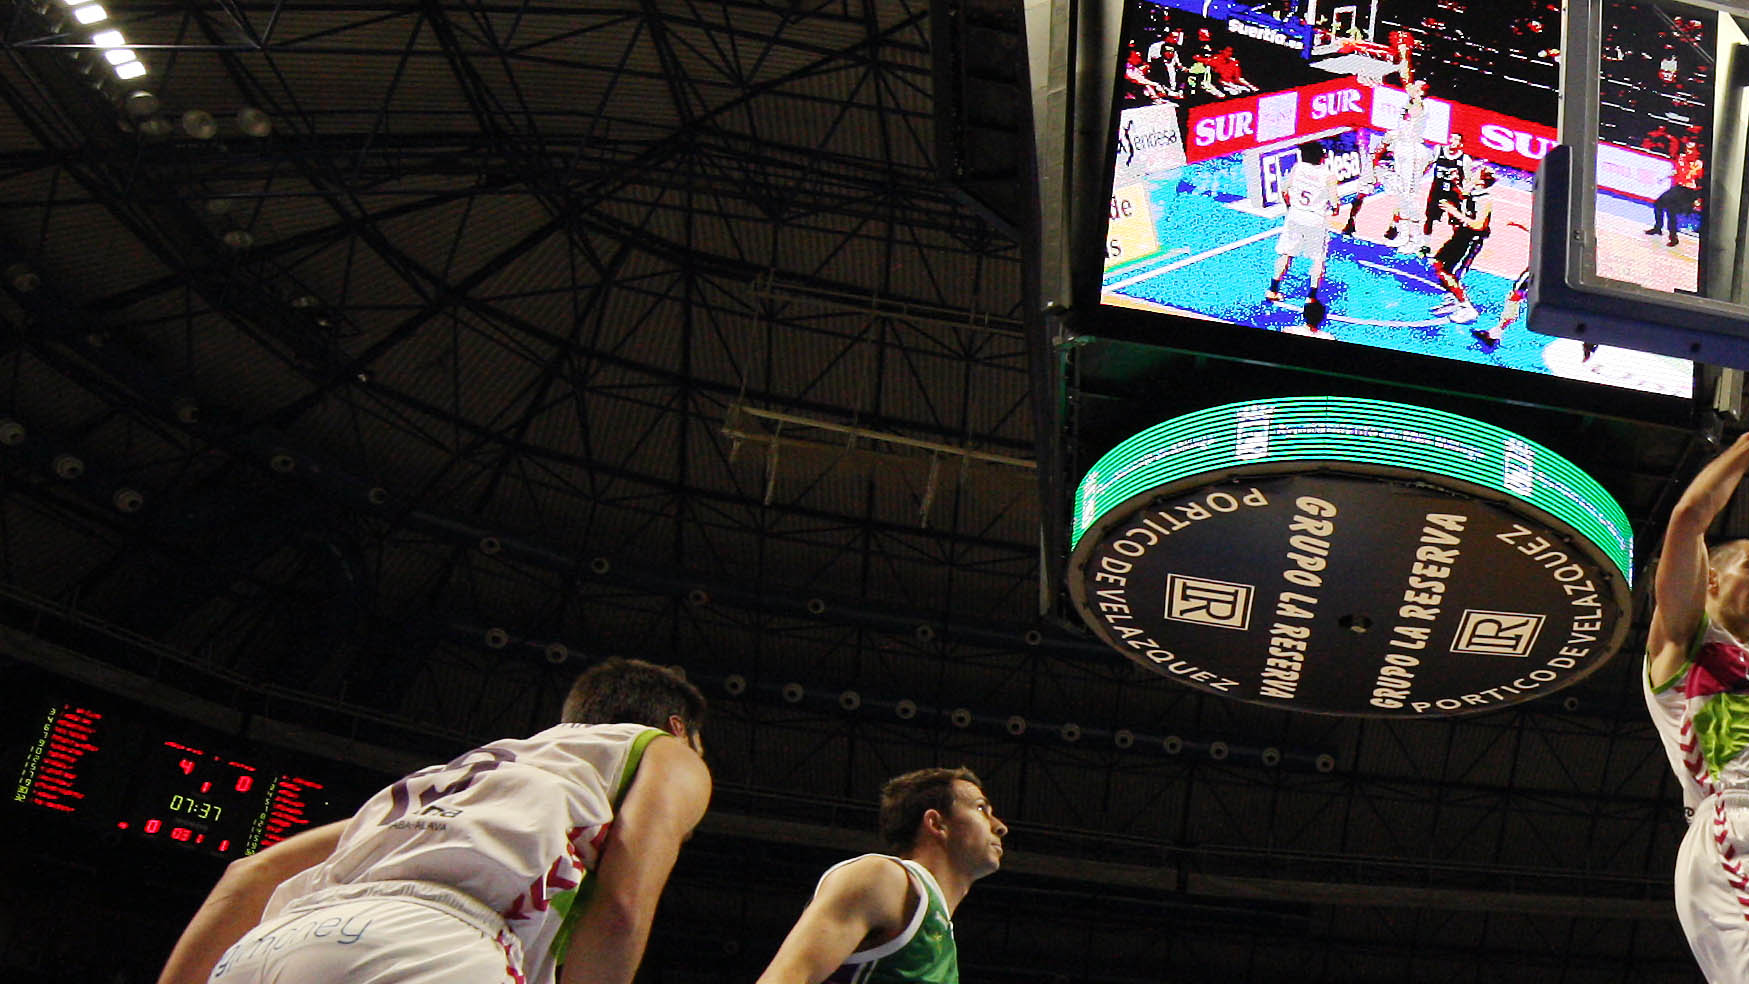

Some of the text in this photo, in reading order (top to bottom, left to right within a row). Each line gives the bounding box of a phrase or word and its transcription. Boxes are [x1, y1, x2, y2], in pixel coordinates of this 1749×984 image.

[1311, 88, 1364, 120] SUR
[1194, 111, 1254, 147] SUR
[1479, 124, 1562, 159] SU
[1113, 487, 1269, 557] PORTICO
[1096, 556, 1133, 587] DE
[1496, 523, 1602, 644] VELAZQUEZ
[1260, 496, 1337, 699] GRUPO LA RESERVA
[1369, 513, 1467, 710] GRUPO LA RESERVA
[1096, 588, 1240, 692] VELAZQUEZ
[1547, 646, 1589, 669] DE
[1410, 669, 1557, 713] PORTICO
[170, 795, 221, 821] 07:37
